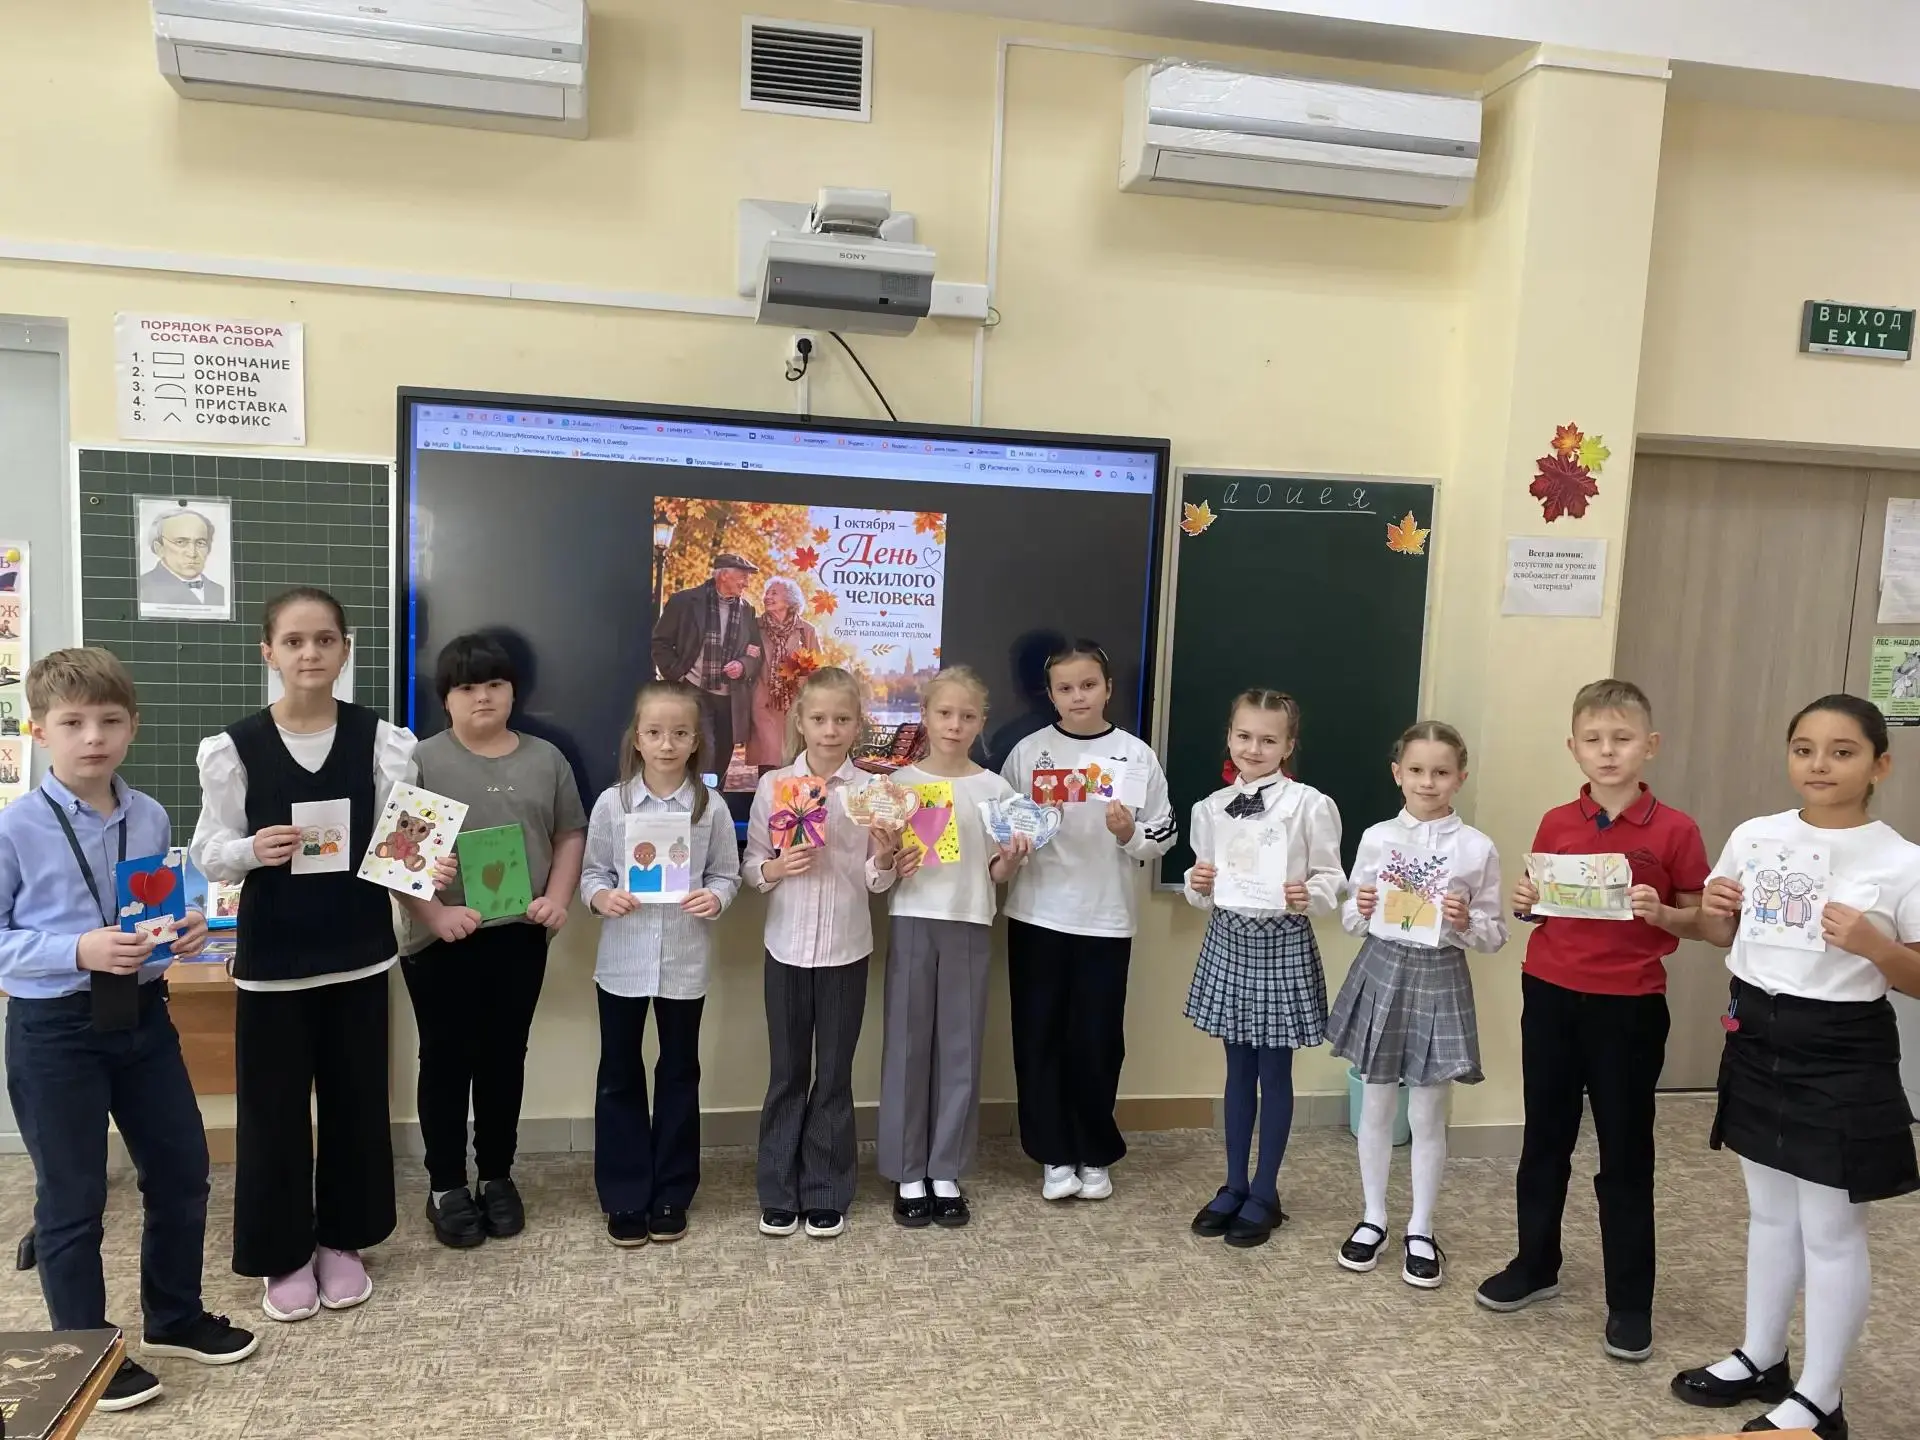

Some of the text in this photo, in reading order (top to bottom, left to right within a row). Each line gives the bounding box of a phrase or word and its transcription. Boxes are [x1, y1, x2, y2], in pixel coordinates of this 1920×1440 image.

[840, 252, 867, 260] SONY
[1819, 306, 1901, 332] ВЫХОД
[141, 320, 283, 337] ПОРЯДОК РАЗБОРА
[150, 332, 274, 348] СОСТАВА СЛОВА
[1828, 329, 1888, 348] EXIT
[132, 352, 291, 370] 1. ОКОНЧАНИЕ
[132, 366, 261, 383] 2. ОСНОВА
[132, 381, 258, 397] 3. КОРЕНЬ
[132, 396, 288, 413] 4. ПРИСТАВКА
[133, 410, 272, 427] 5. СУФФИКС
[833, 515, 841, 530] 1
[844, 518, 896, 533] октября
[834, 533, 918, 569] День
[1528, 549, 1554, 557] Всегда
[832, 570, 936, 588] пожилого
[1533, 582, 1573, 591] материала!
[845, 589, 936, 607] человека
[845, 617, 925, 629] Пусть каждый день
[833, 626, 932, 639] будет наполнен теплом
[1876, 638, 1889, 646] ЛЕС
